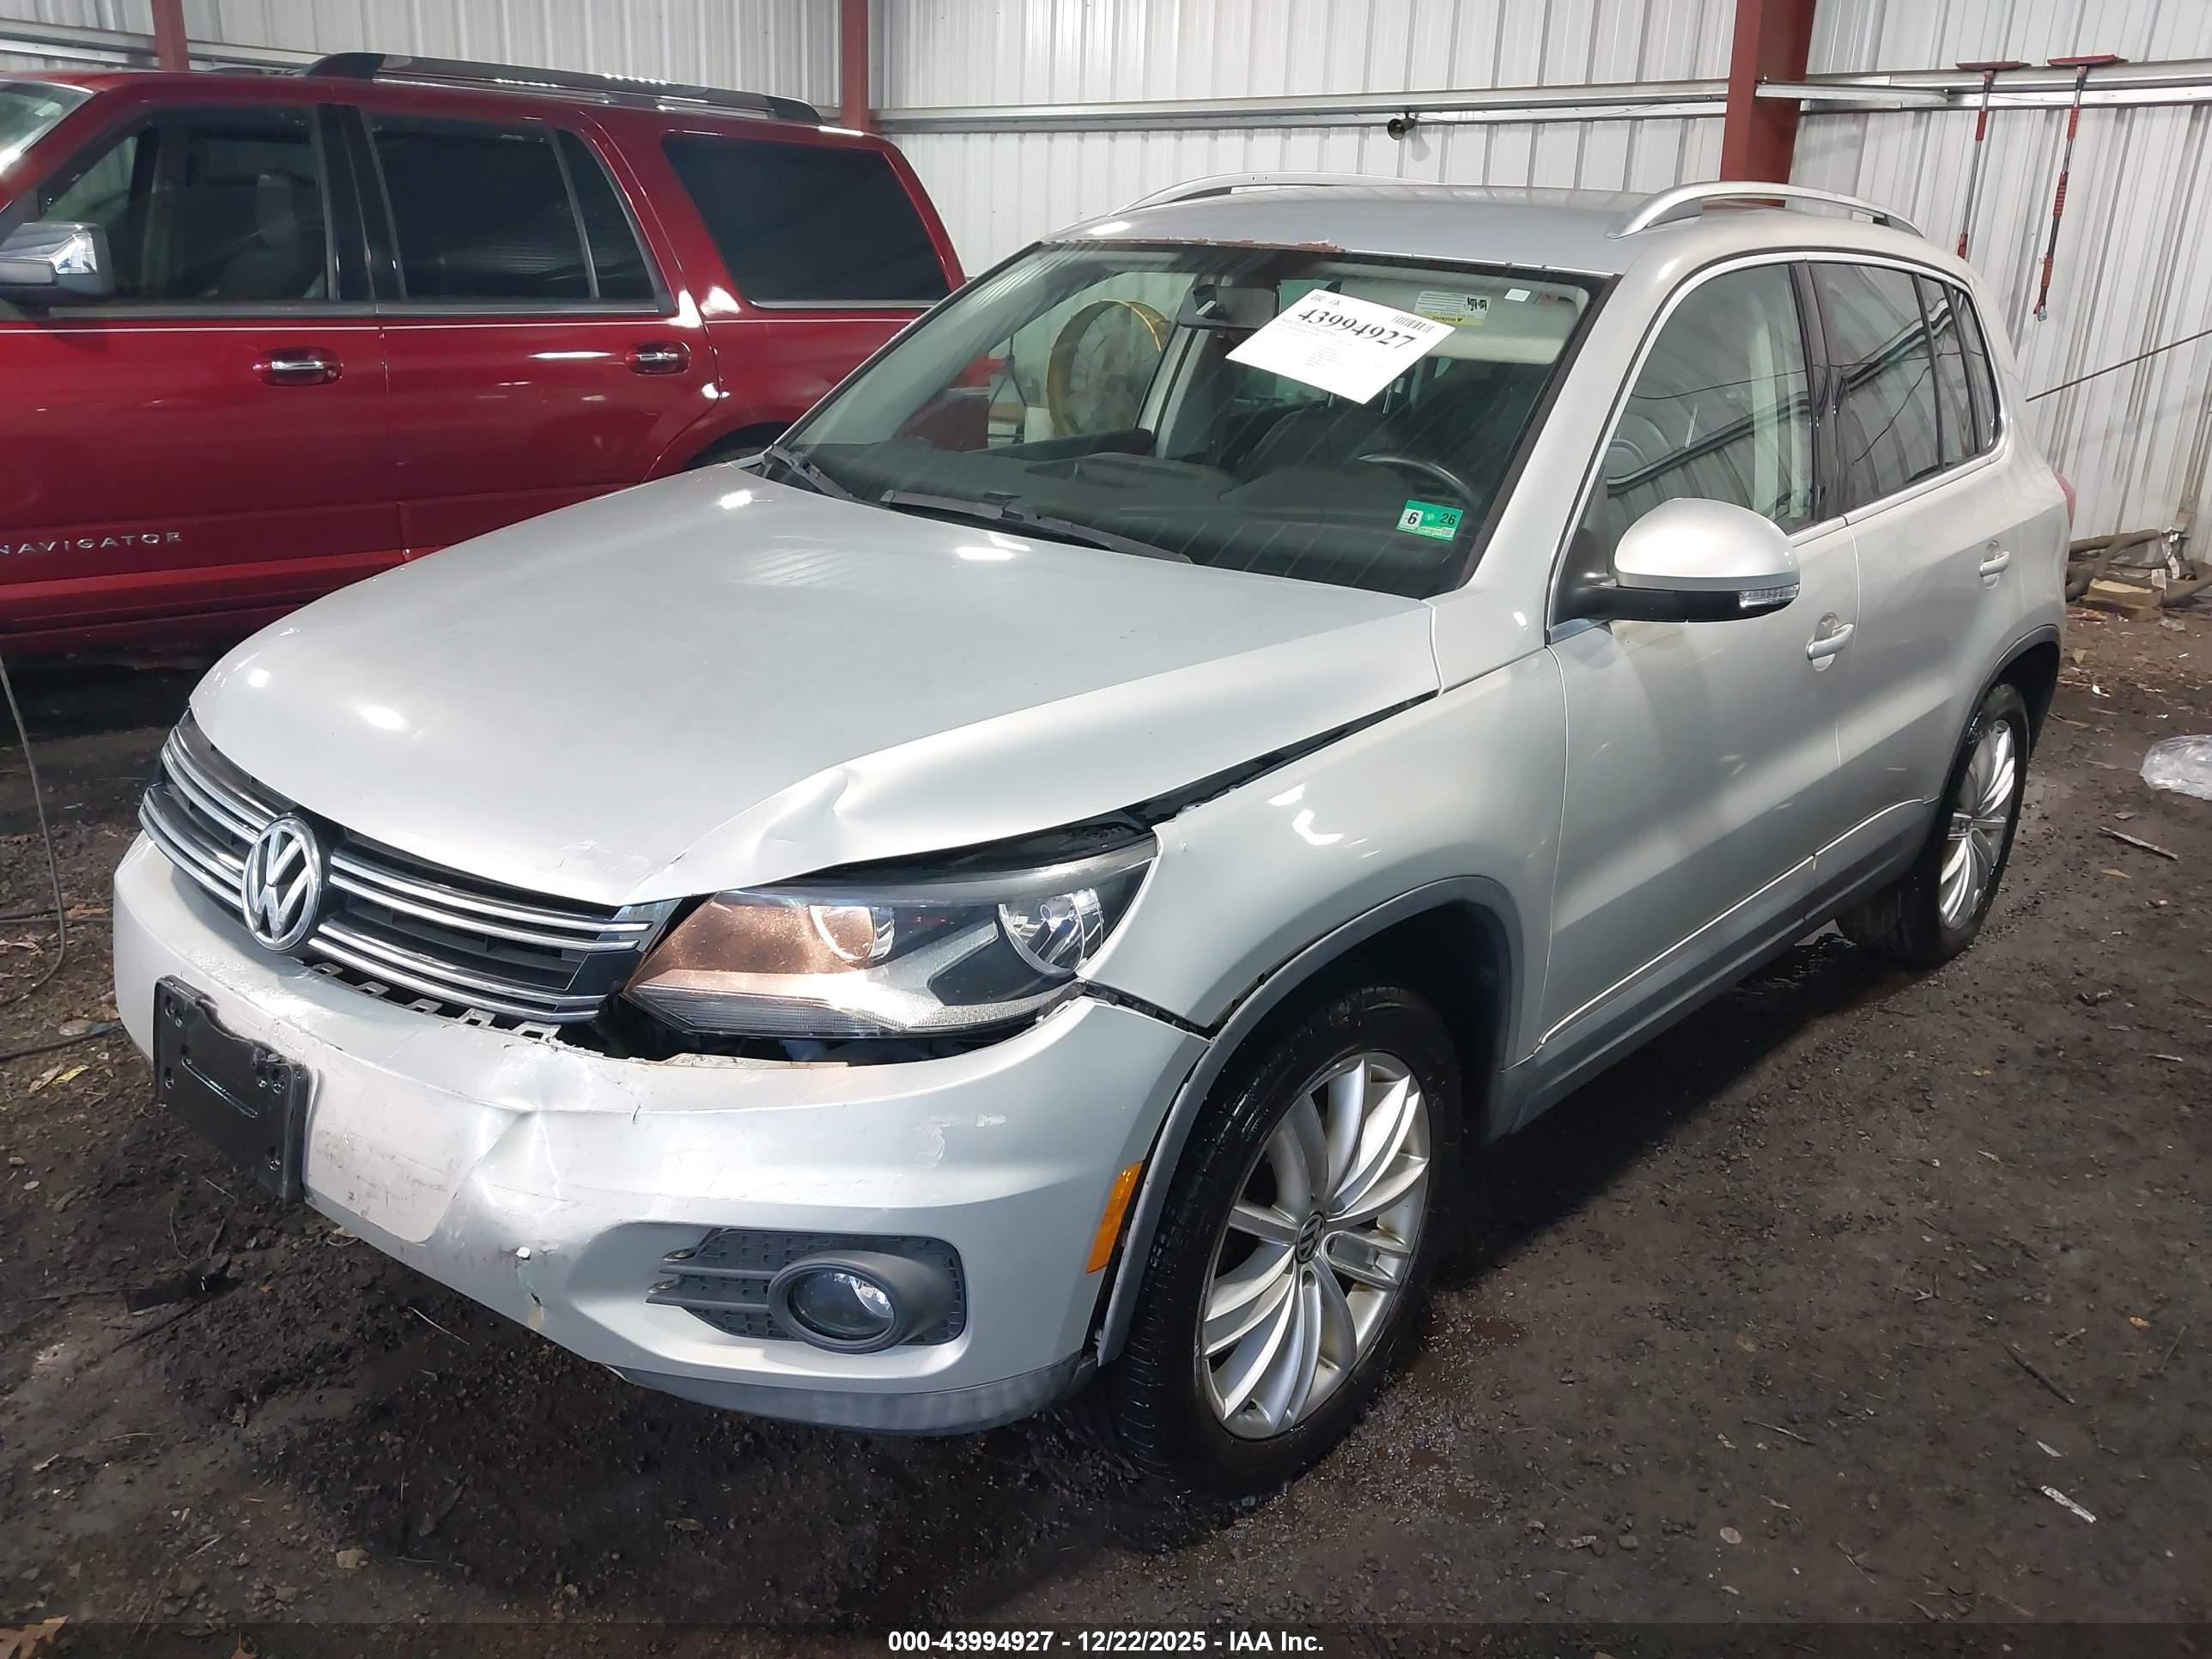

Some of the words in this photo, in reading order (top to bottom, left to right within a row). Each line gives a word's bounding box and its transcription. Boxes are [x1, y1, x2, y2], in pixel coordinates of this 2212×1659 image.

[1298, 308, 1416, 349] 43994927
[1407, 512, 1419, 525] 6
[1440, 513, 1457, 526] 26
